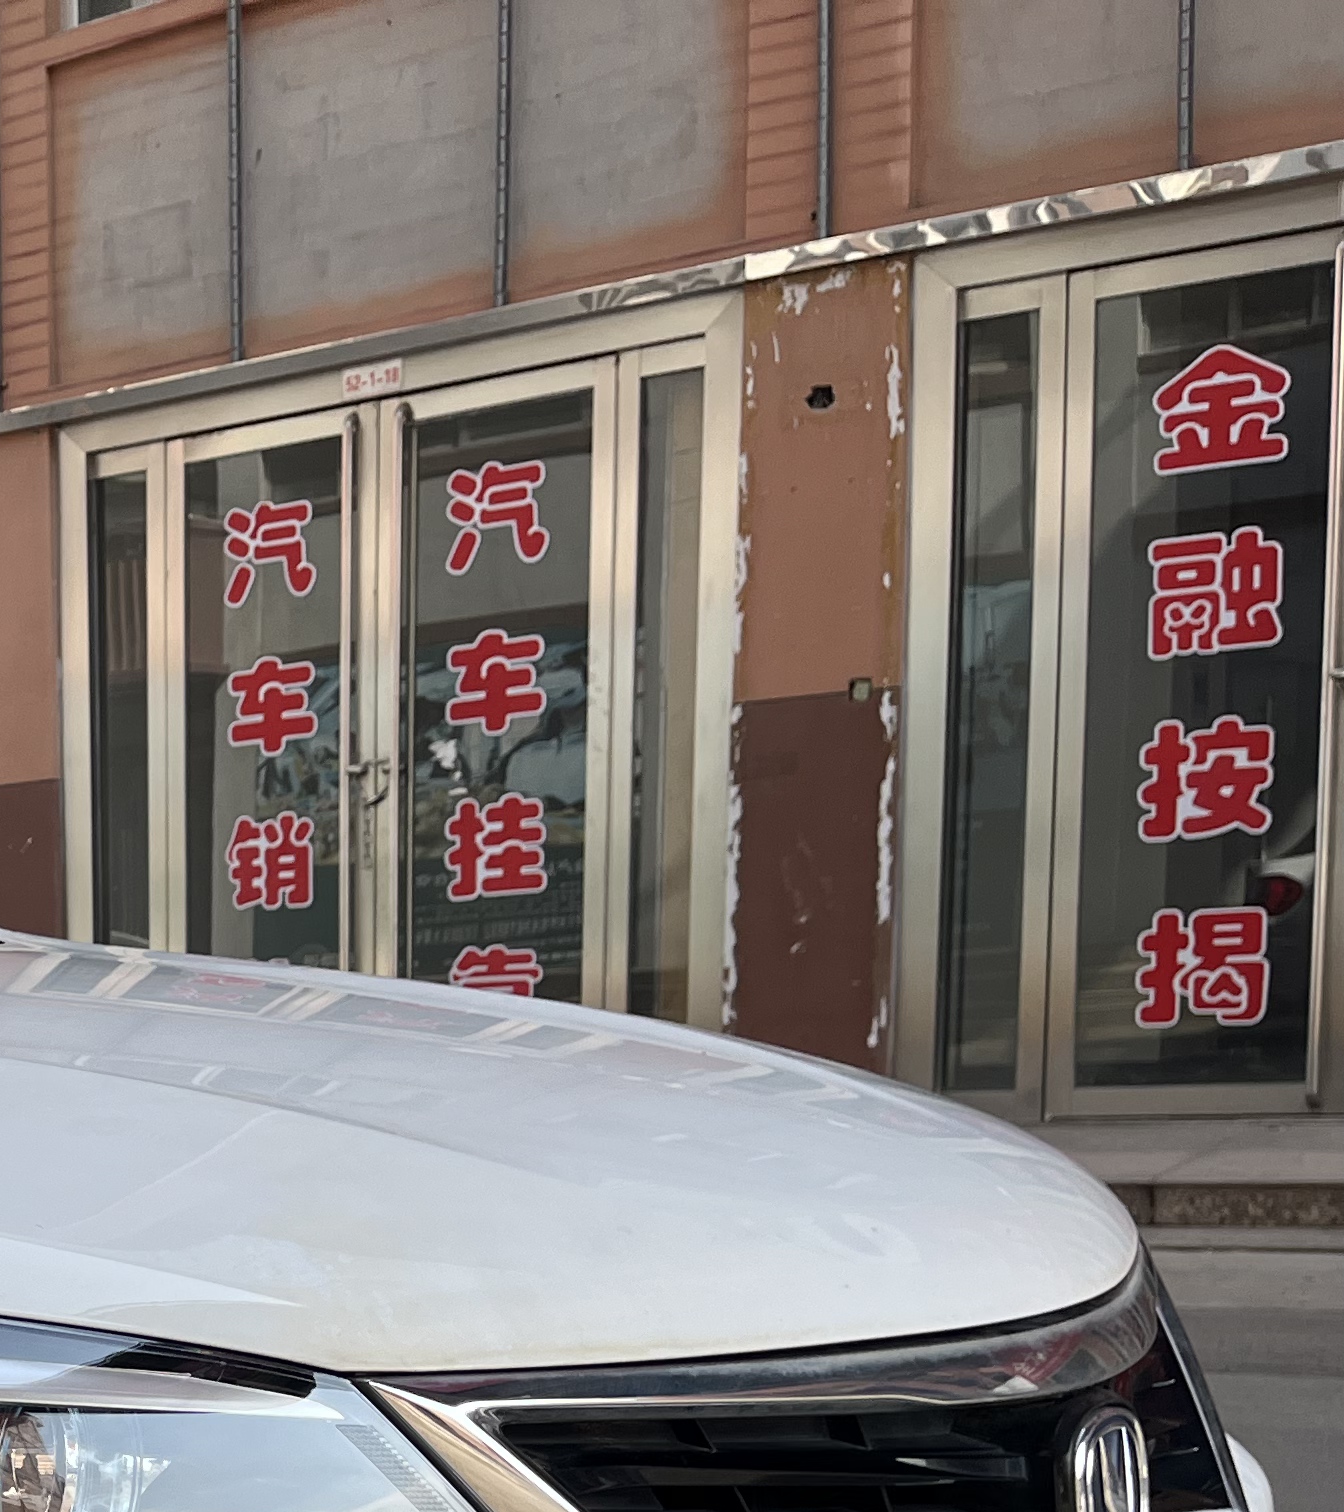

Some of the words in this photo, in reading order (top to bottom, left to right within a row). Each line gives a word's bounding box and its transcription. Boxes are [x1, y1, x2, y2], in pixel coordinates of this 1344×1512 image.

[222, 499, 318, 910] 汽车销
[1135, 344, 1291, 1030] 金融按揭
